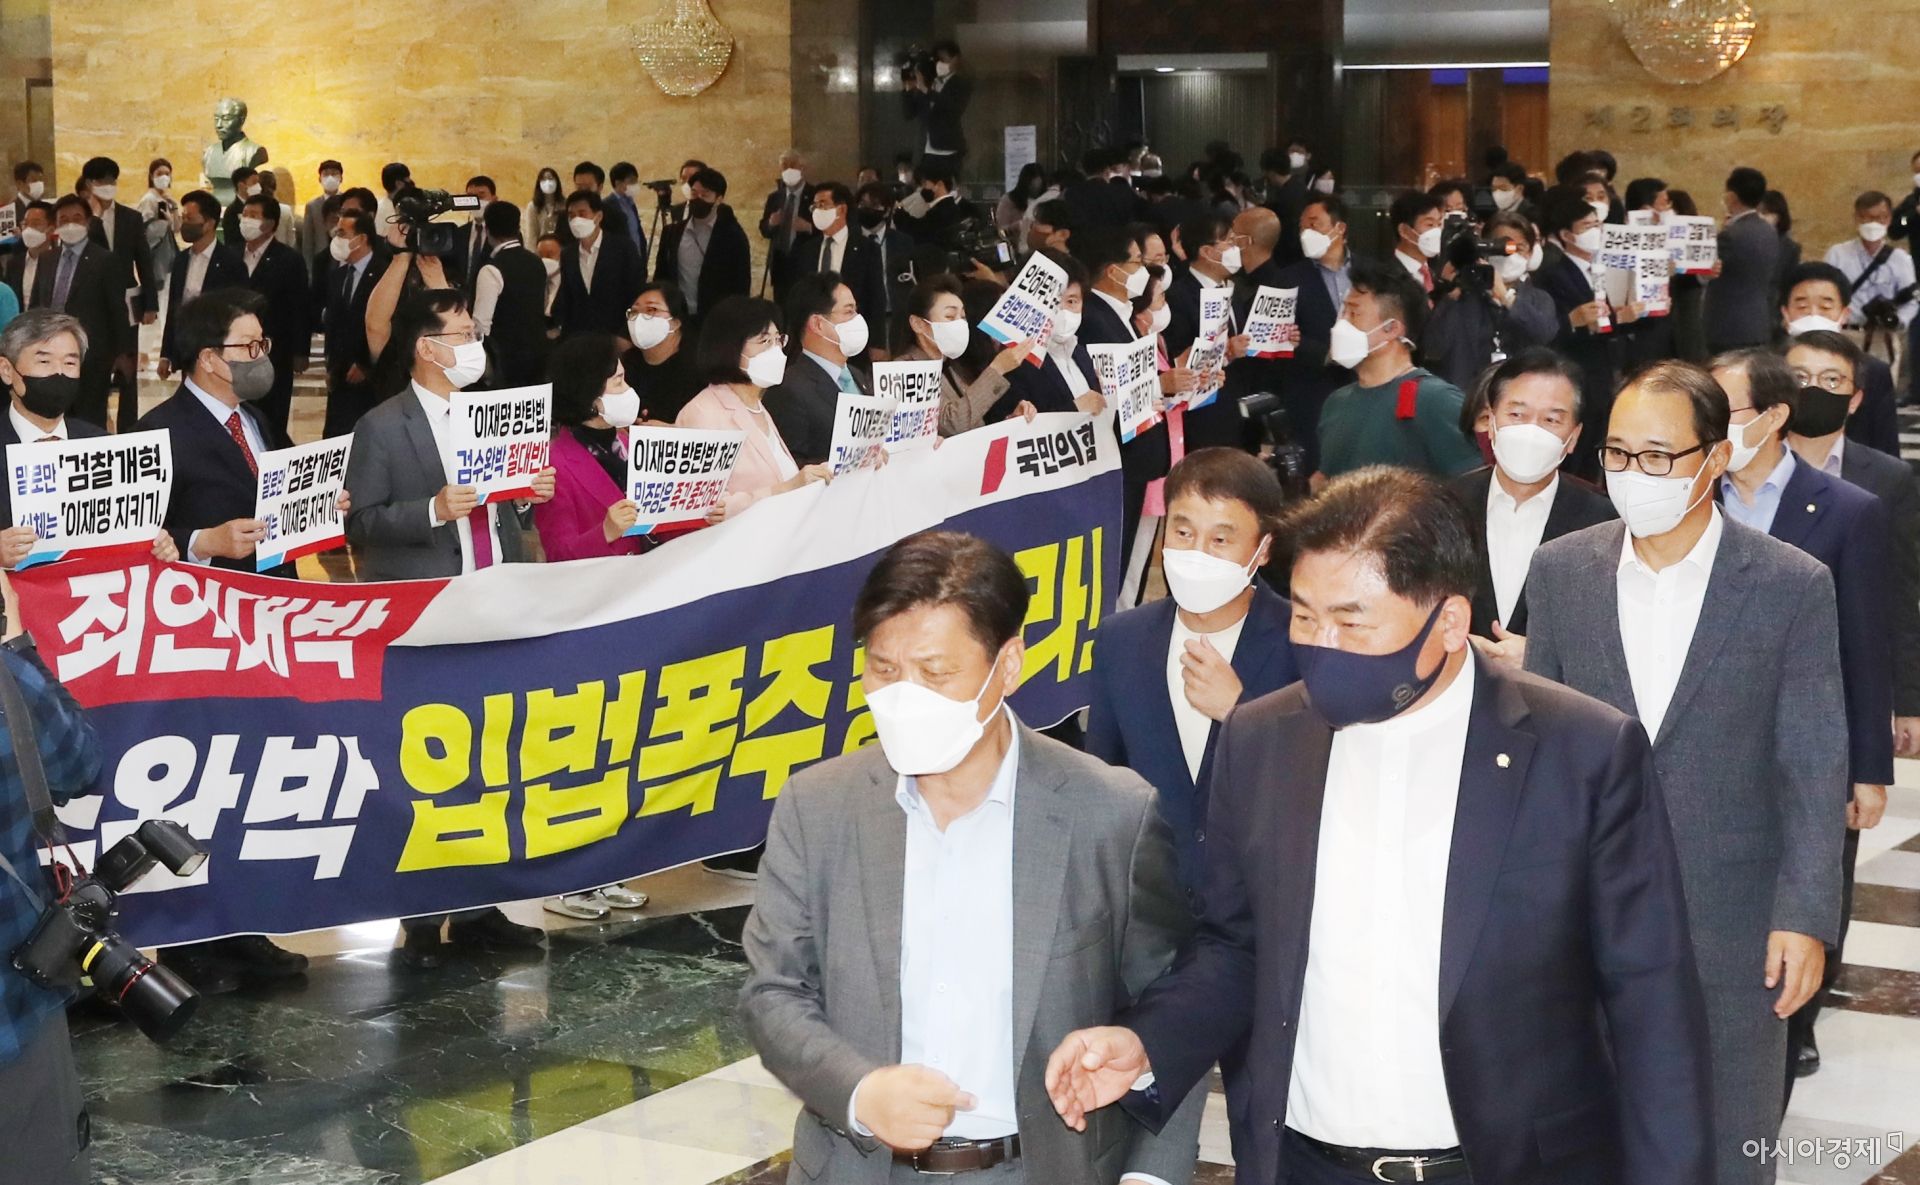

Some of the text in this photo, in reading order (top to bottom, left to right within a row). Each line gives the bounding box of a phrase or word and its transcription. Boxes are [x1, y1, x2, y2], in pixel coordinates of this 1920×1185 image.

[457, 444, 506, 485] 검수완박
[634, 438, 742, 474] 이재명 방탄법 처리
[1016, 421, 1097, 477] 국민의힘
[16, 463, 57, 495] 말로만
[262, 468, 287, 500] 말로만
[635, 481, 674, 514] 민주당은
[56, 564, 392, 684] 죄인대박
